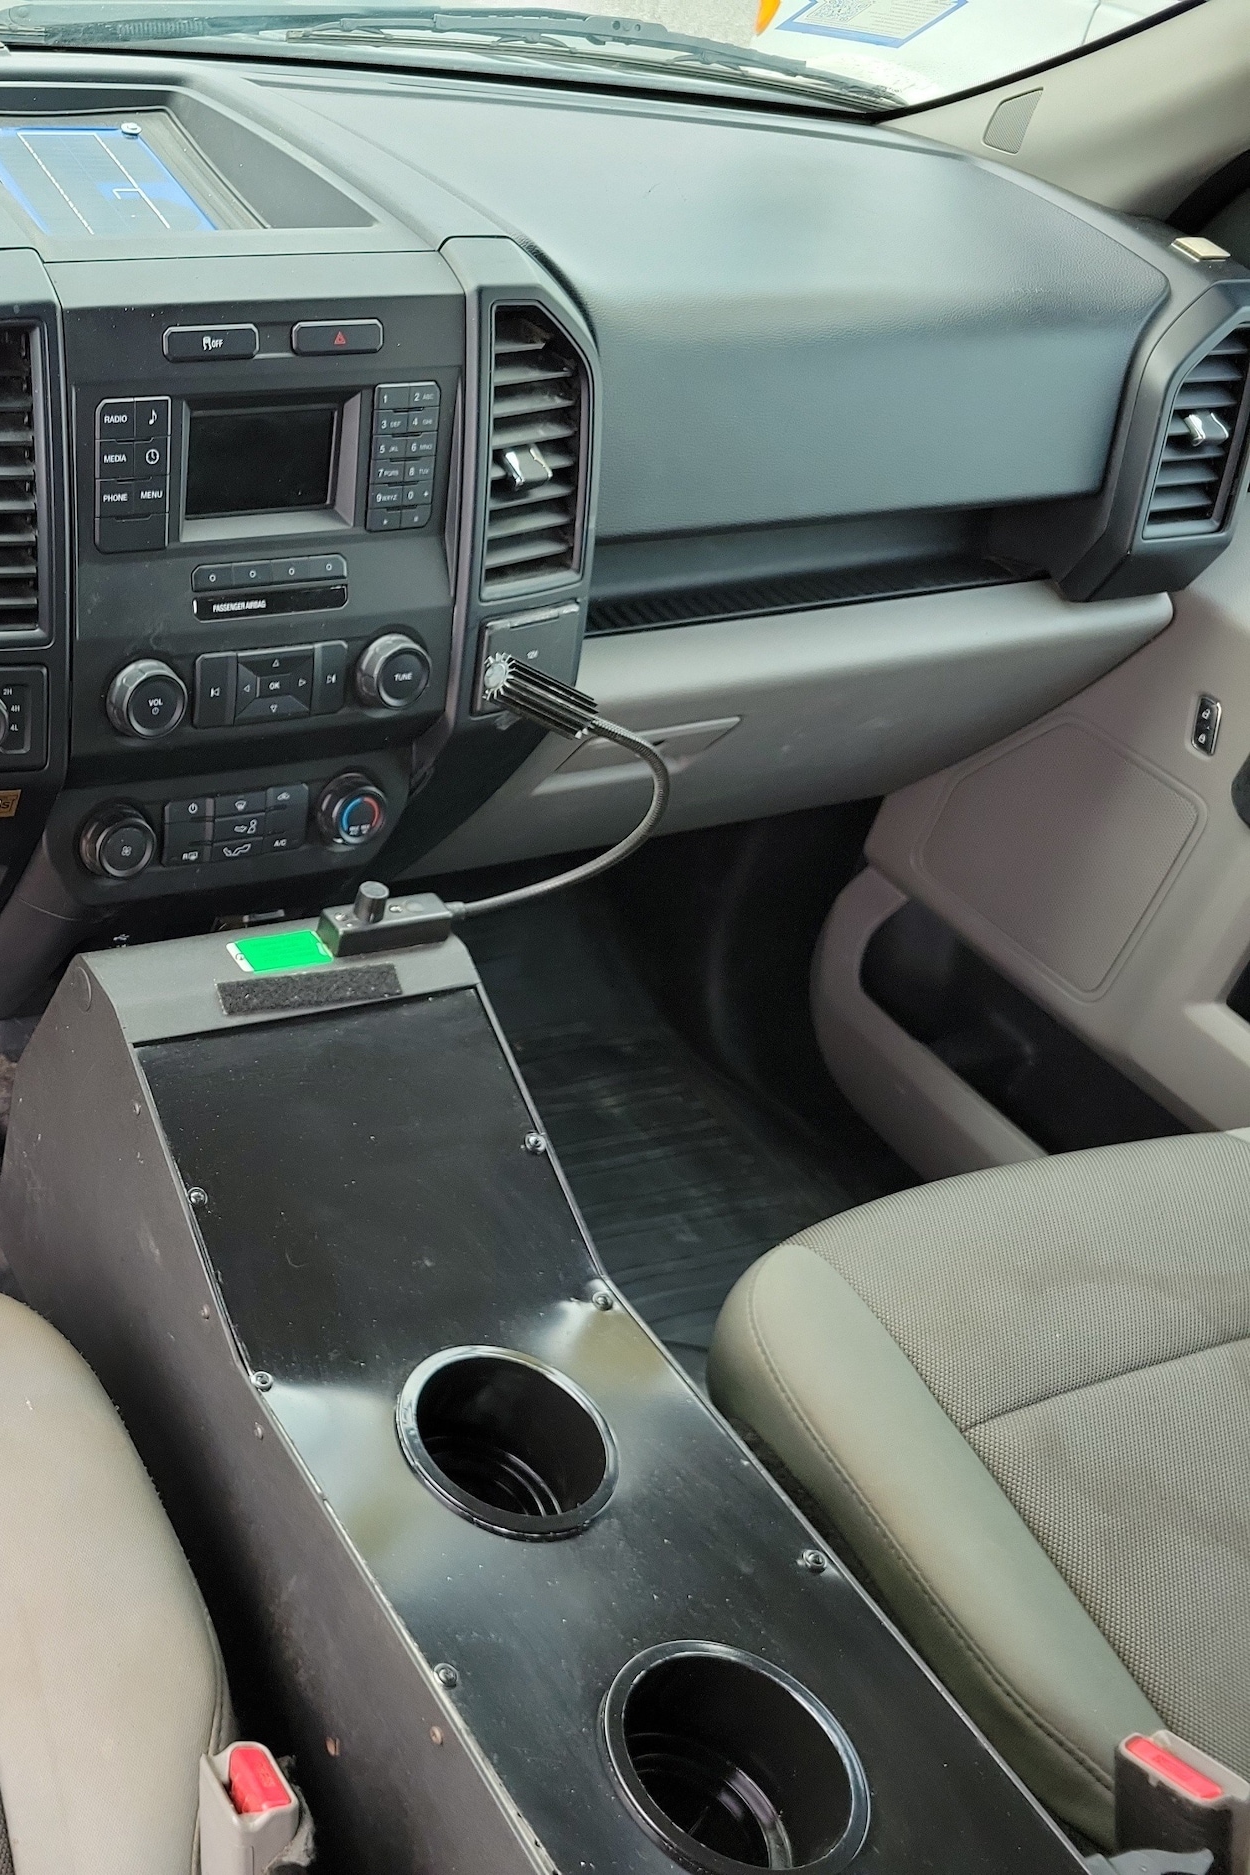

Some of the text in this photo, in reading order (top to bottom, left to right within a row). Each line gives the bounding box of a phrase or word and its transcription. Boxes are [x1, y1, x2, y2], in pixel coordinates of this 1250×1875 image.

[211, 339, 224, 348] OFF
[414, 392, 420, 402] 2
[104, 414, 127, 424] RADIO
[412, 417, 418, 426] 4
[381, 420, 387, 429] 3
[379, 445, 385, 453] 5
[411, 443, 417, 452] 6
[104, 454, 127, 463] MEDIA
[378, 469, 383, 477] 7
[409, 467, 414, 476] 8
[103, 493, 128, 502] PHONE
[141, 490, 163, 499] MENU
[376, 493, 382, 502] 9
[408, 491, 414, 500] 0
[213, 600, 266, 613] PASSENGER AIRBAG
[394, 672, 413, 682] TUNE
[269, 682, 280, 690] OK
[148, 698, 164, 707] VOL
[274, 839, 287, 847] A/C
